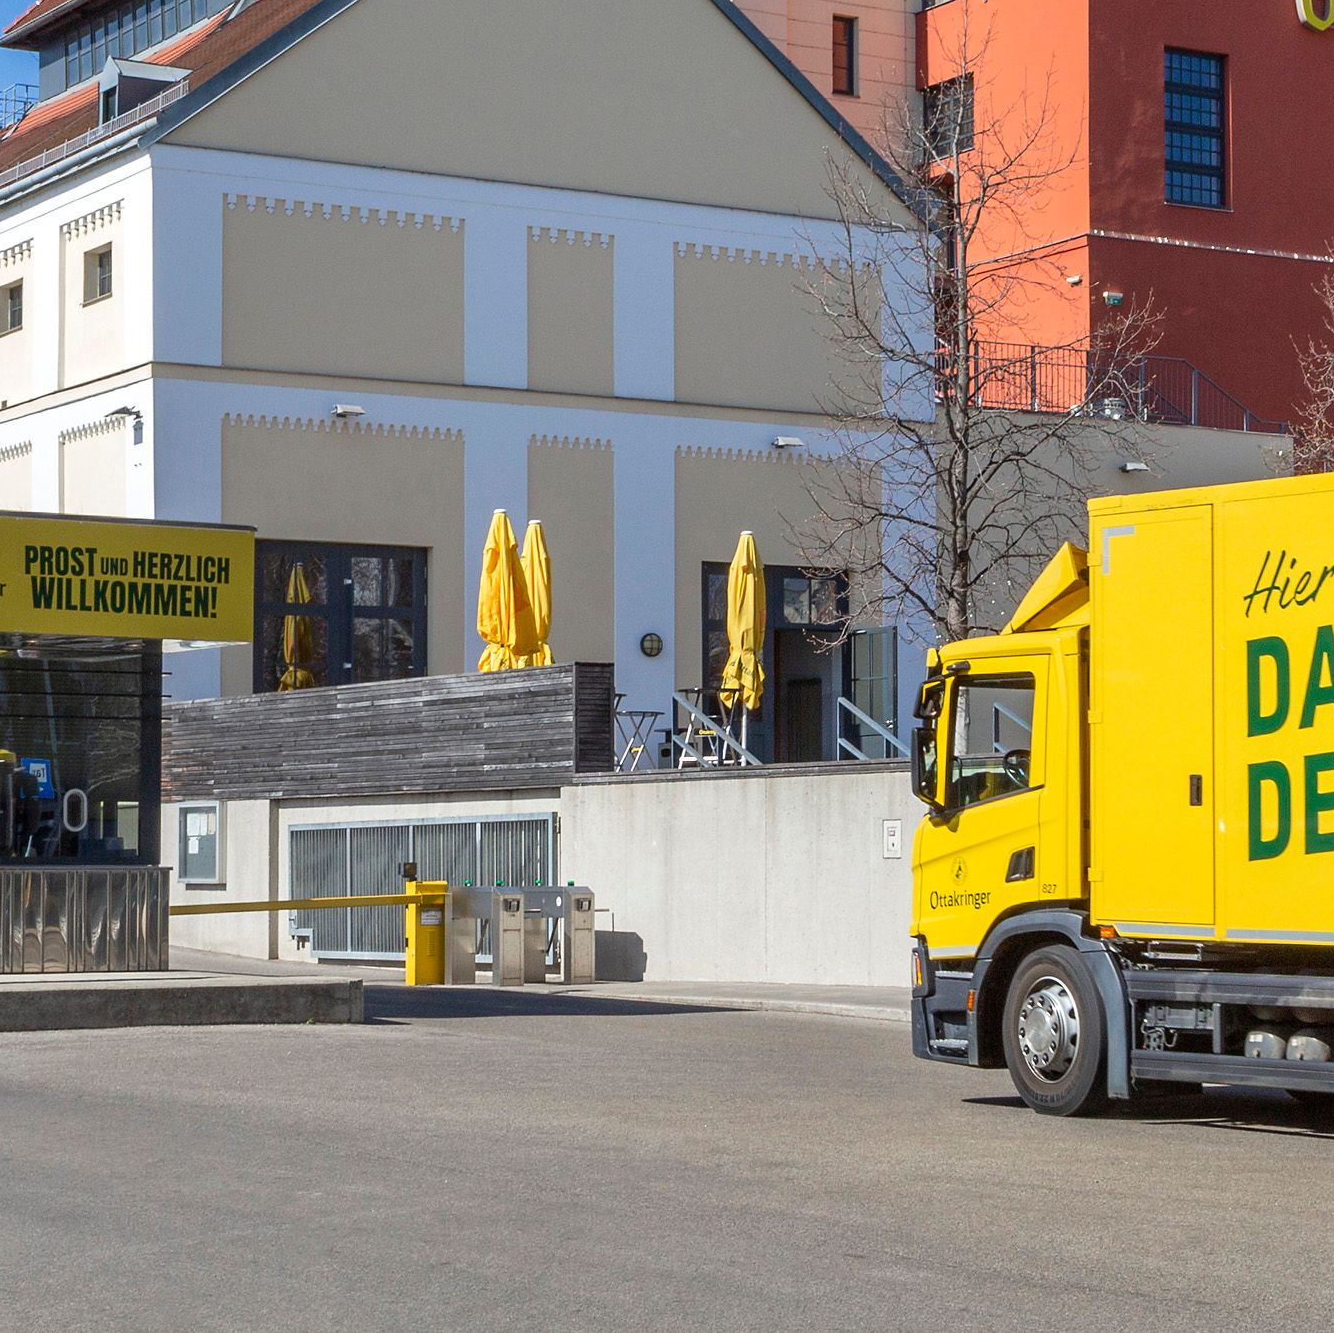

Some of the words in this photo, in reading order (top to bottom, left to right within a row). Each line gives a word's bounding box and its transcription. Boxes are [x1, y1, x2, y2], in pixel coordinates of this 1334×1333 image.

[24, 545, 98, 577] PROST
[100, 557, 128, 576] UND
[133, 551, 231, 585] HERZLICH
[30, 576, 218, 619] WILLKOMMEN!
[929, 889, 992, 910] Ottakringer
